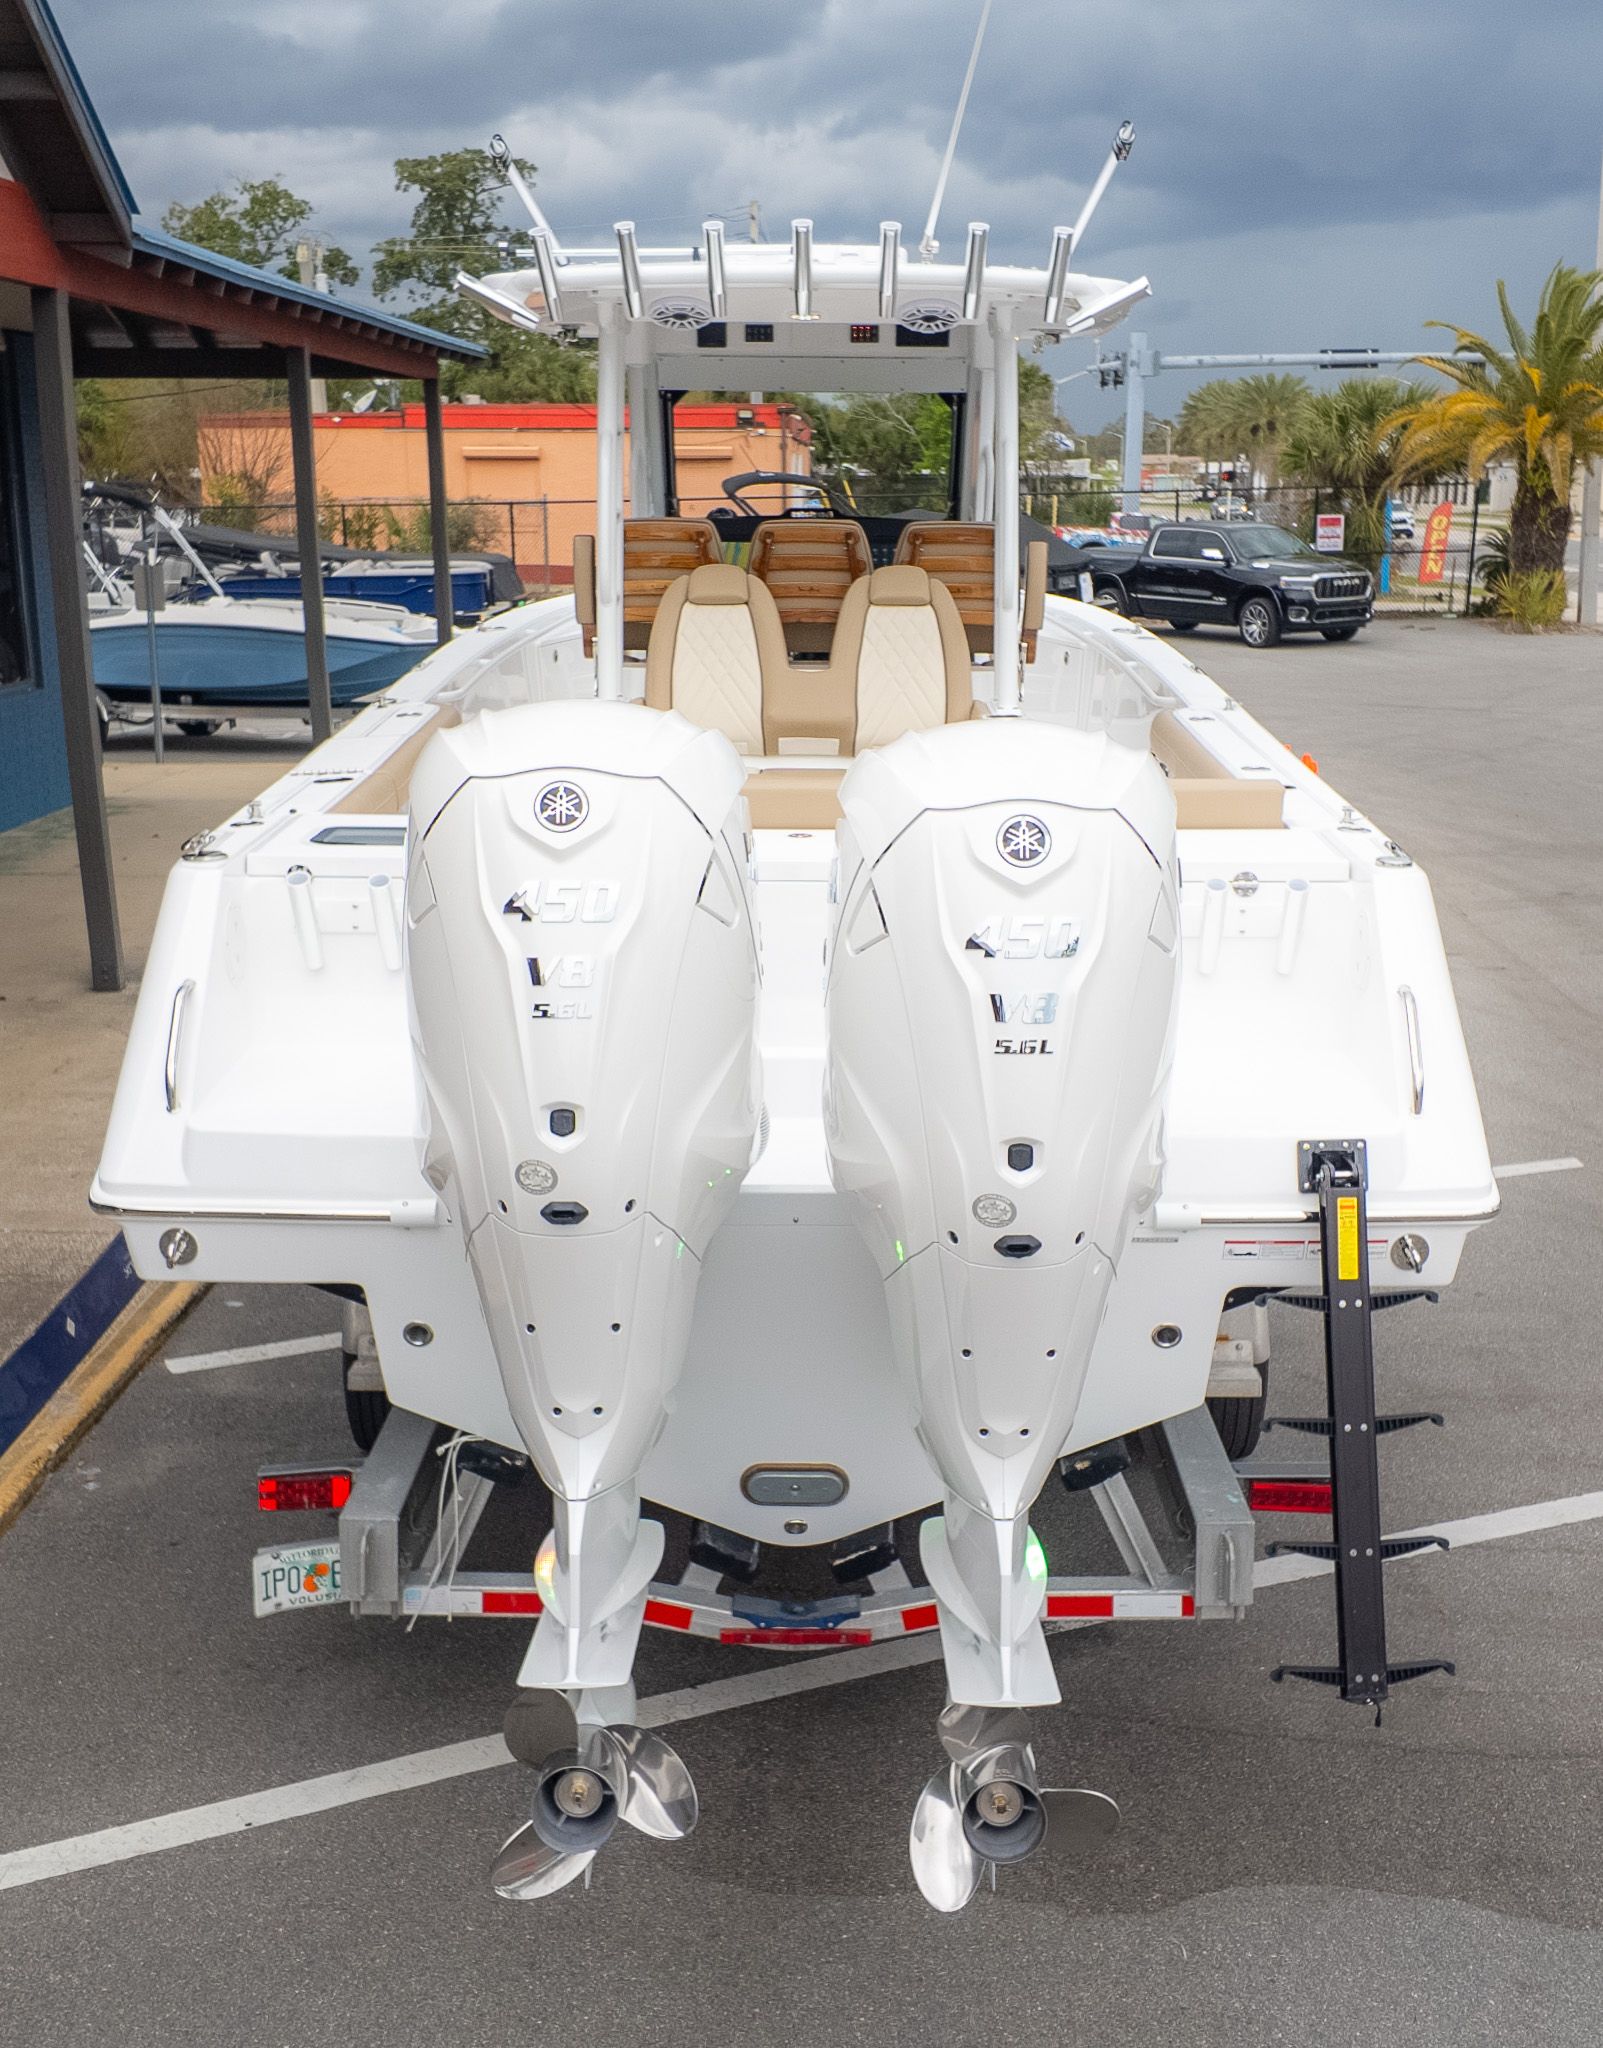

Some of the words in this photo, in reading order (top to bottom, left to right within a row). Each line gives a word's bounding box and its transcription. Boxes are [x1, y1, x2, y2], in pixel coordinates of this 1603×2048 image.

[1425, 514, 1449, 575] OPEN
[503, 880, 621, 924] 450
[965, 915, 1080, 960] 450
[526, 955, 596, 988] V8
[990, 992, 1059, 1025] V8
[994, 1039, 1053, 1055] 5.6L
